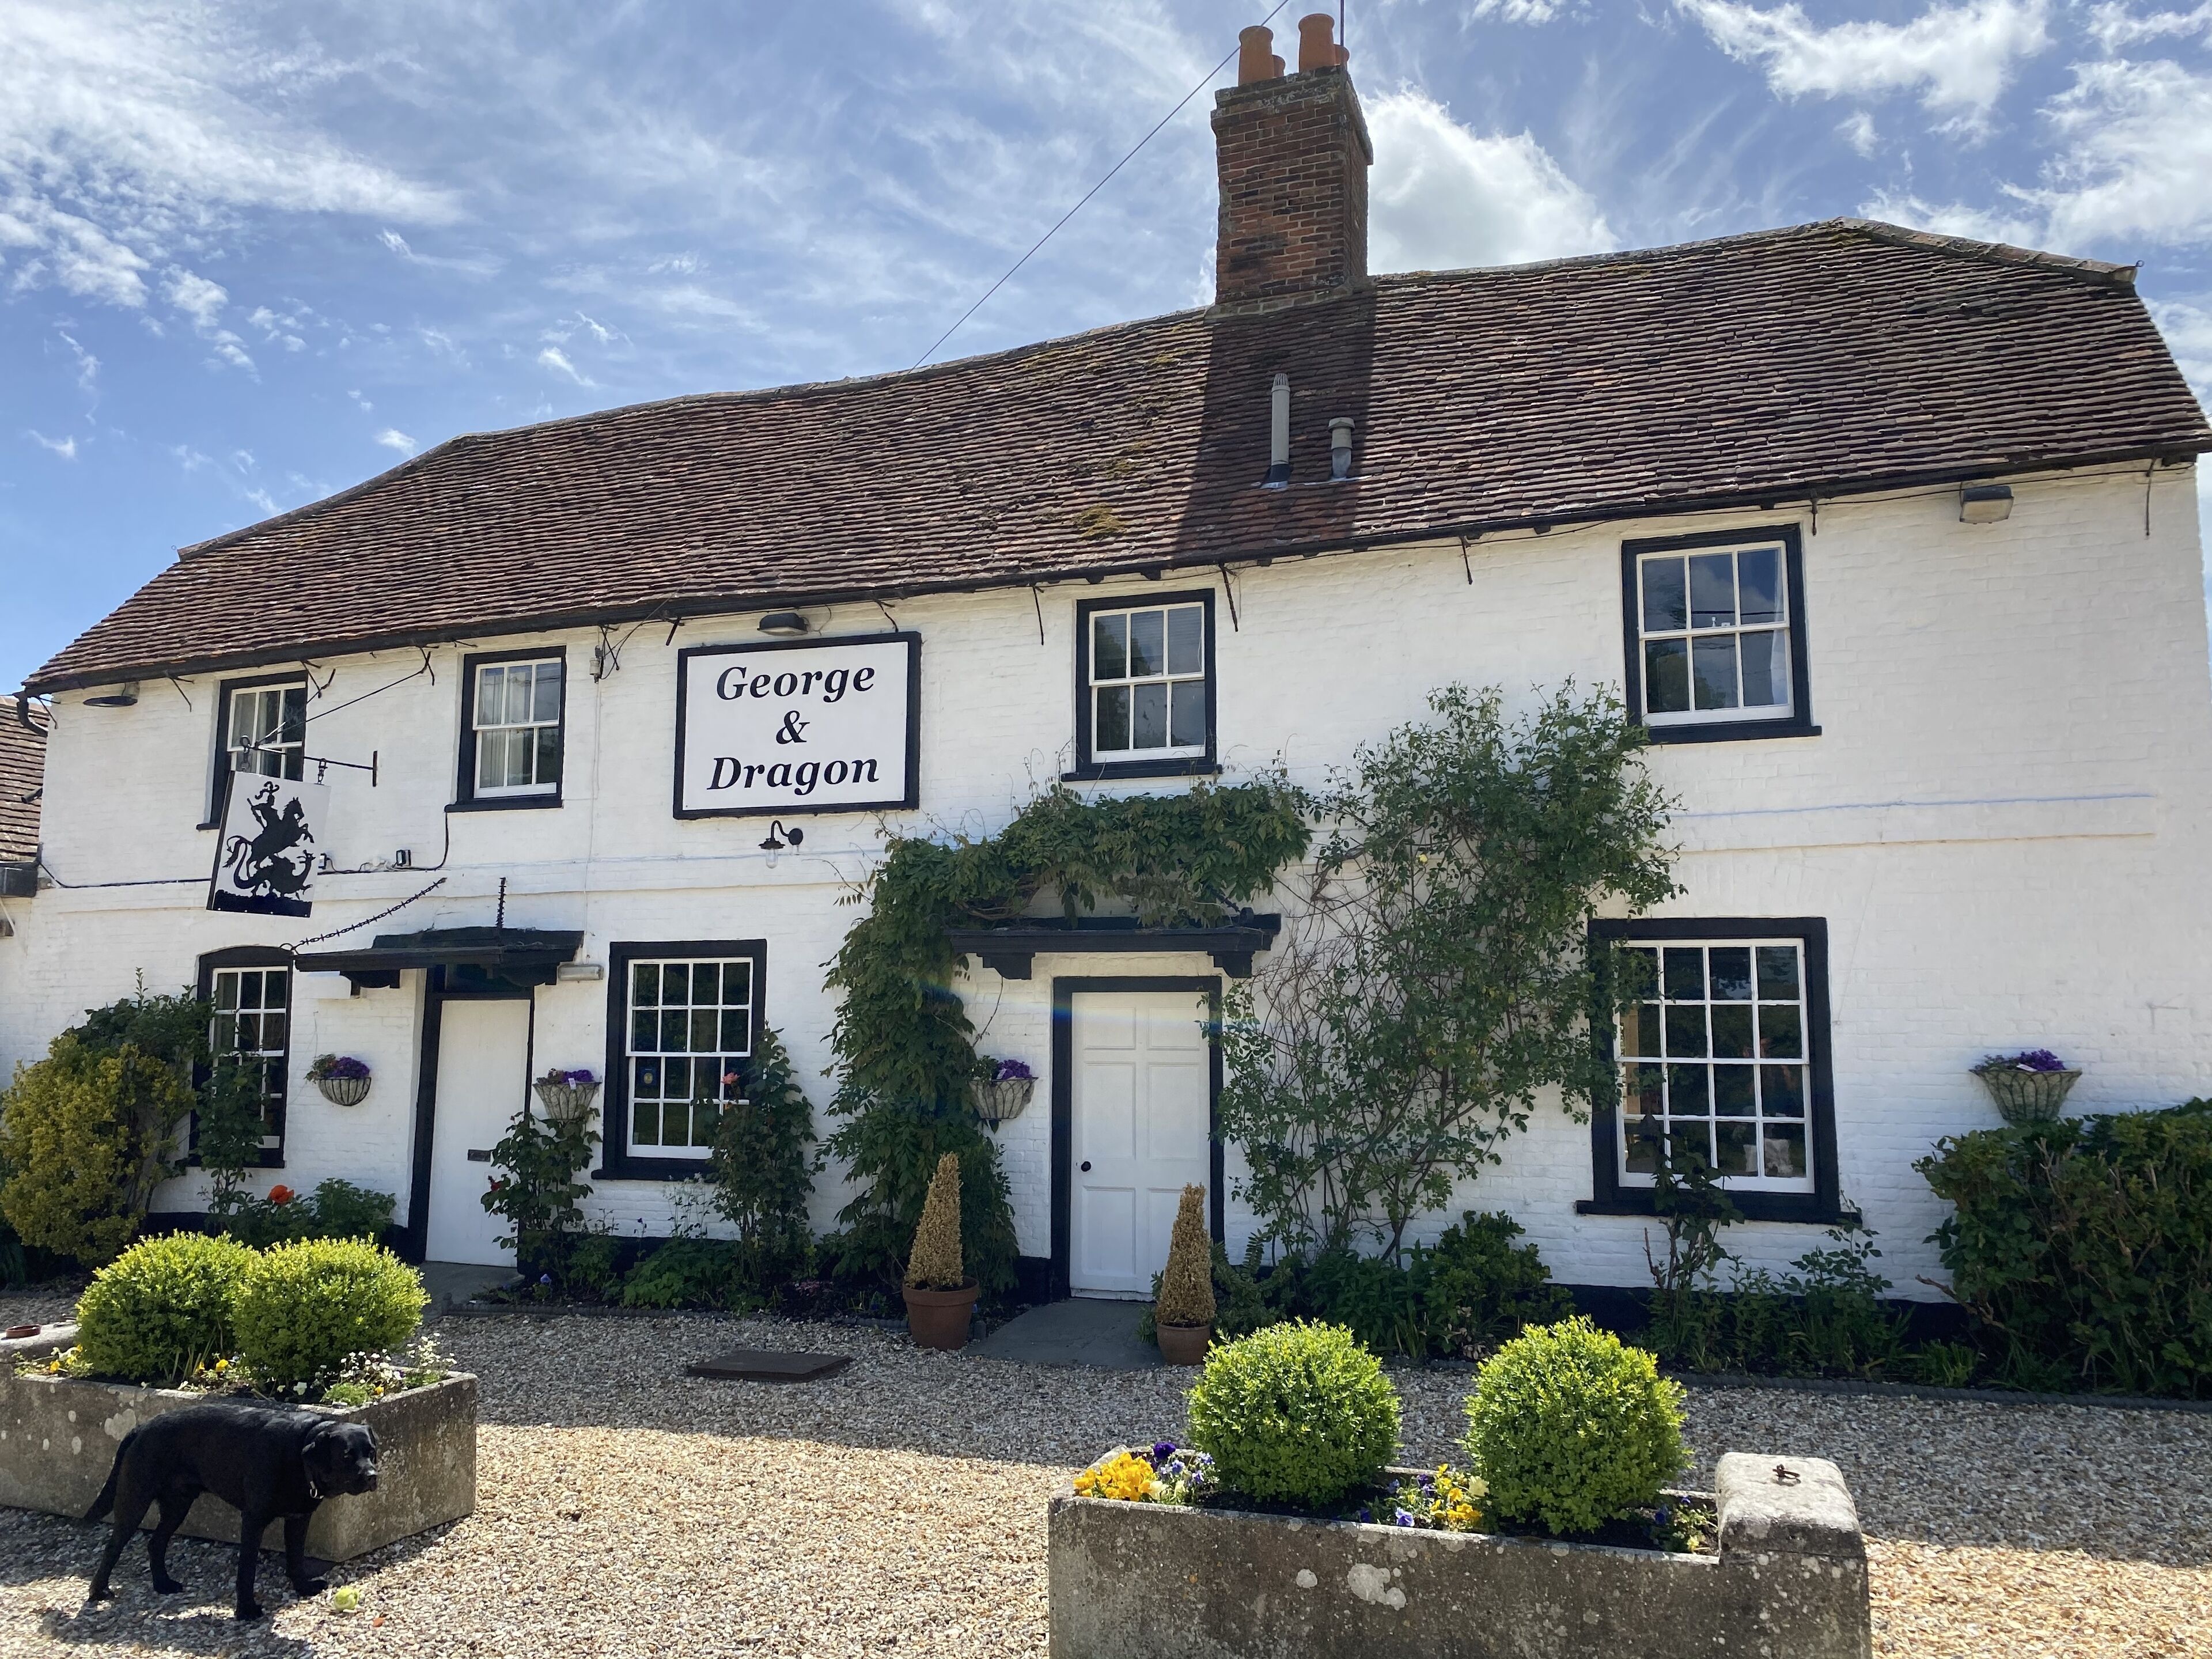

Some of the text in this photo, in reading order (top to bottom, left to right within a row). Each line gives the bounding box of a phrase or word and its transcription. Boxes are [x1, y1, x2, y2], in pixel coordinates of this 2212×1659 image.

[717, 666, 875, 703] George
[775, 710, 810, 745] &
[706, 757, 880, 796] Dragon
